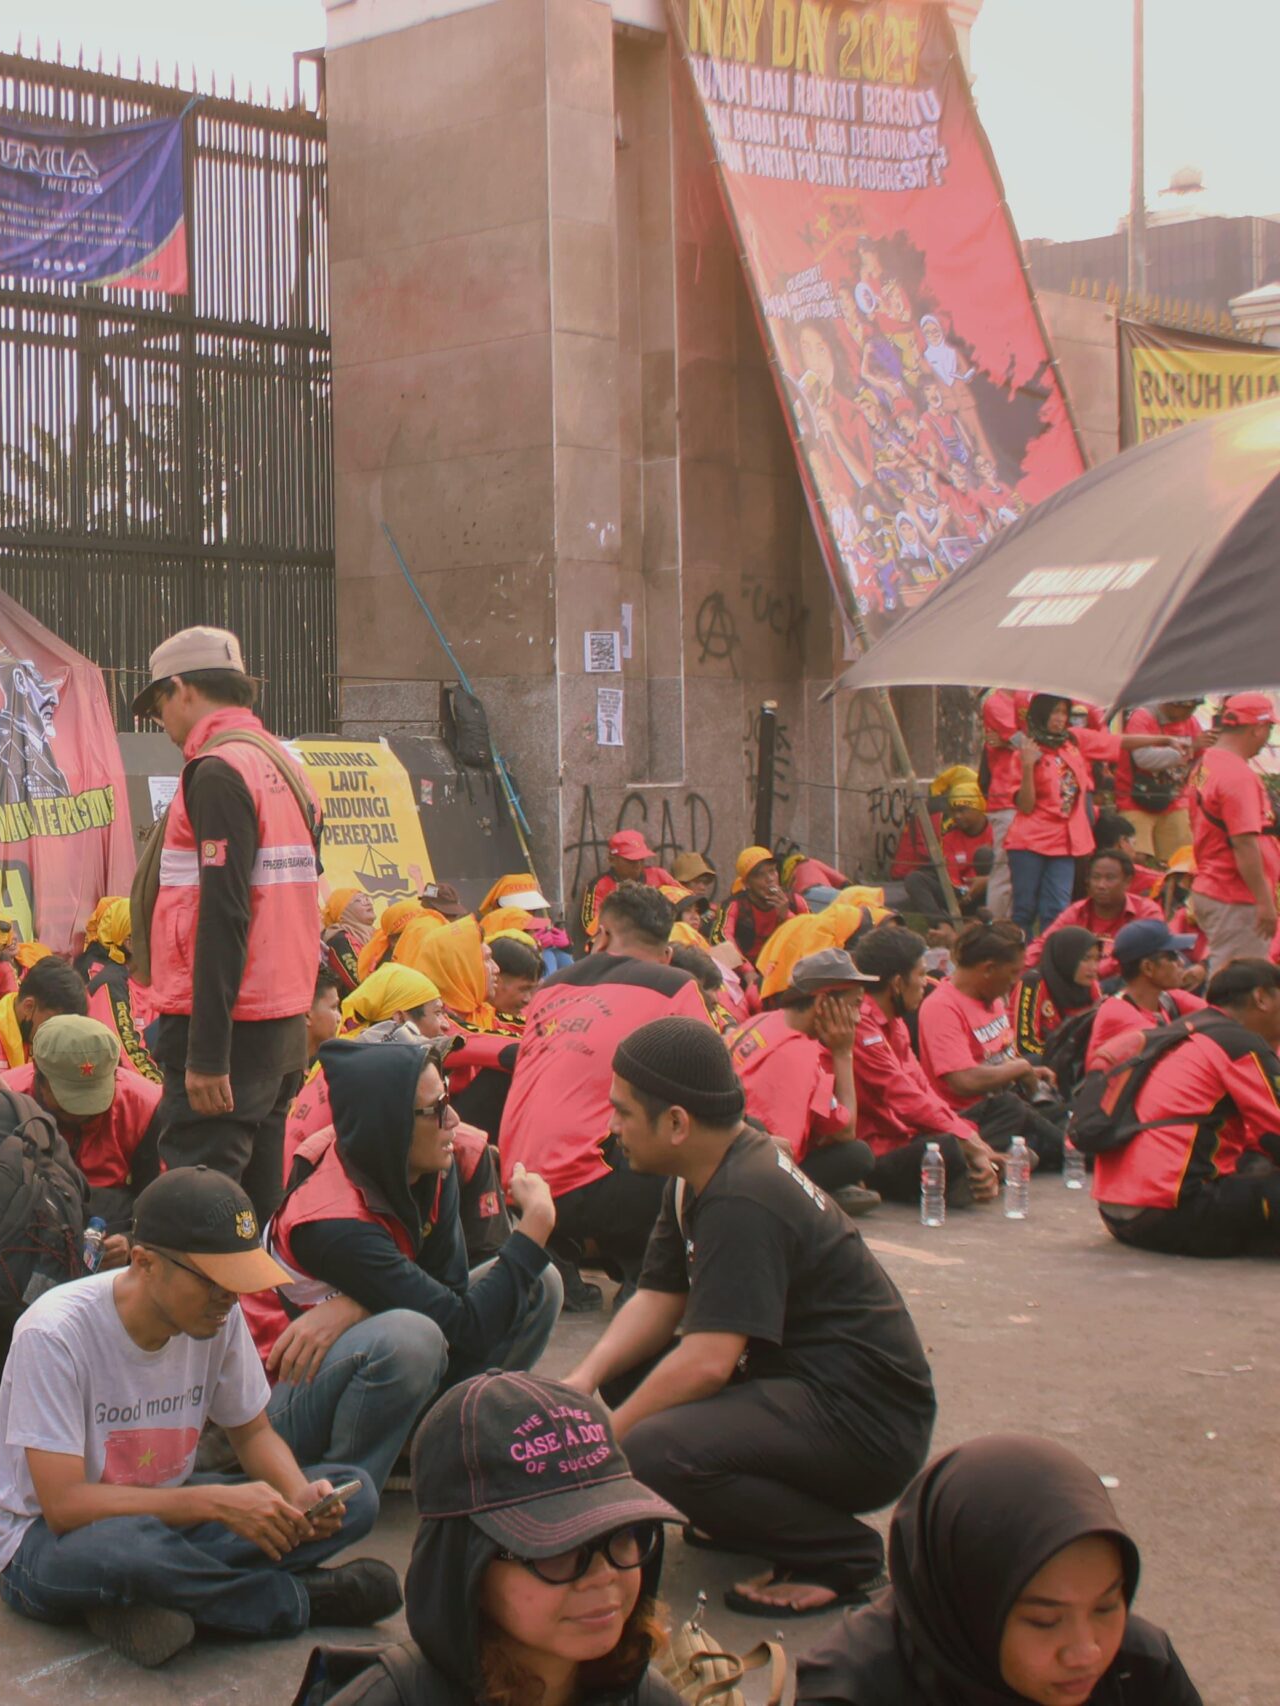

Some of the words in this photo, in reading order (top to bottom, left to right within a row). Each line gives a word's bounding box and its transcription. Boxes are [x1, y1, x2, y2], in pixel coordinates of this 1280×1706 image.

[688, 0, 766, 64] MAY
[771, 0, 832, 75] DAY
[838, 9, 919, 85] 2025
[750, 67, 789, 112] DAN
[793, 72, 857, 121] RAKYAT
[48, 179, 67, 192] MEI
[1140, 369, 1221, 411] BURUH
[300, 752, 379, 768] LINDUNGI
[329, 771, 376, 794] LAUT,
[323, 823, 399, 846] PEKERJA!
[94, 1400, 141, 1425] Good
[146, 1384, 204, 1419] morning
[513, 1413, 543, 1438] THE
[549, 1405, 591, 1423] LINES
[510, 1431, 562, 1462] CASE
[564, 1428, 579, 1446] A
[578, 1424, 608, 1445] DOT
[525, 1461, 547, 1474] OF
[559, 1445, 611, 1474] SUCCESS
